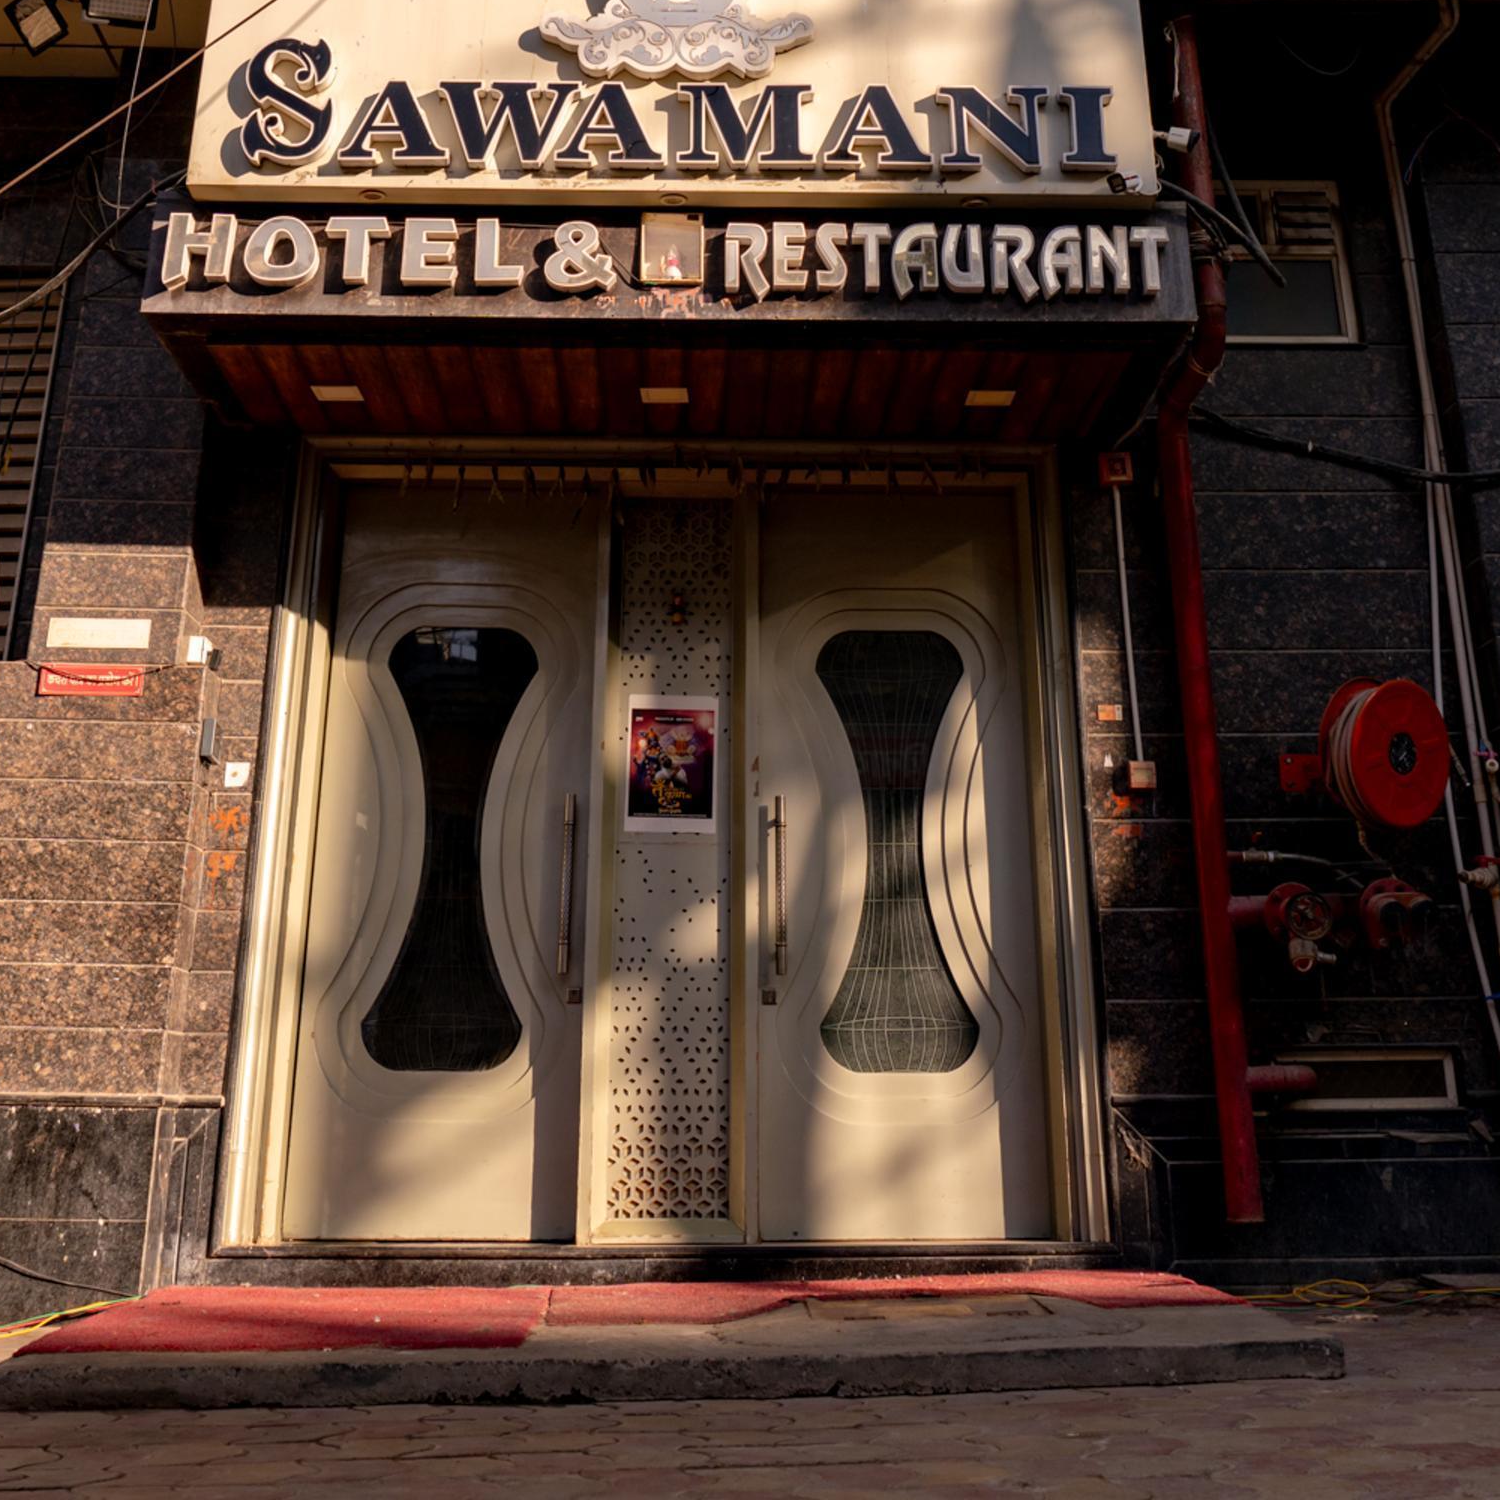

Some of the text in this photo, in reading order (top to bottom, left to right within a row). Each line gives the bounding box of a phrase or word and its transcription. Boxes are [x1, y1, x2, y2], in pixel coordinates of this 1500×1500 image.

[244, 38, 1120, 176] SAWAMANI
[159, 211, 1171, 303] HOTEL & RESTAURANT
